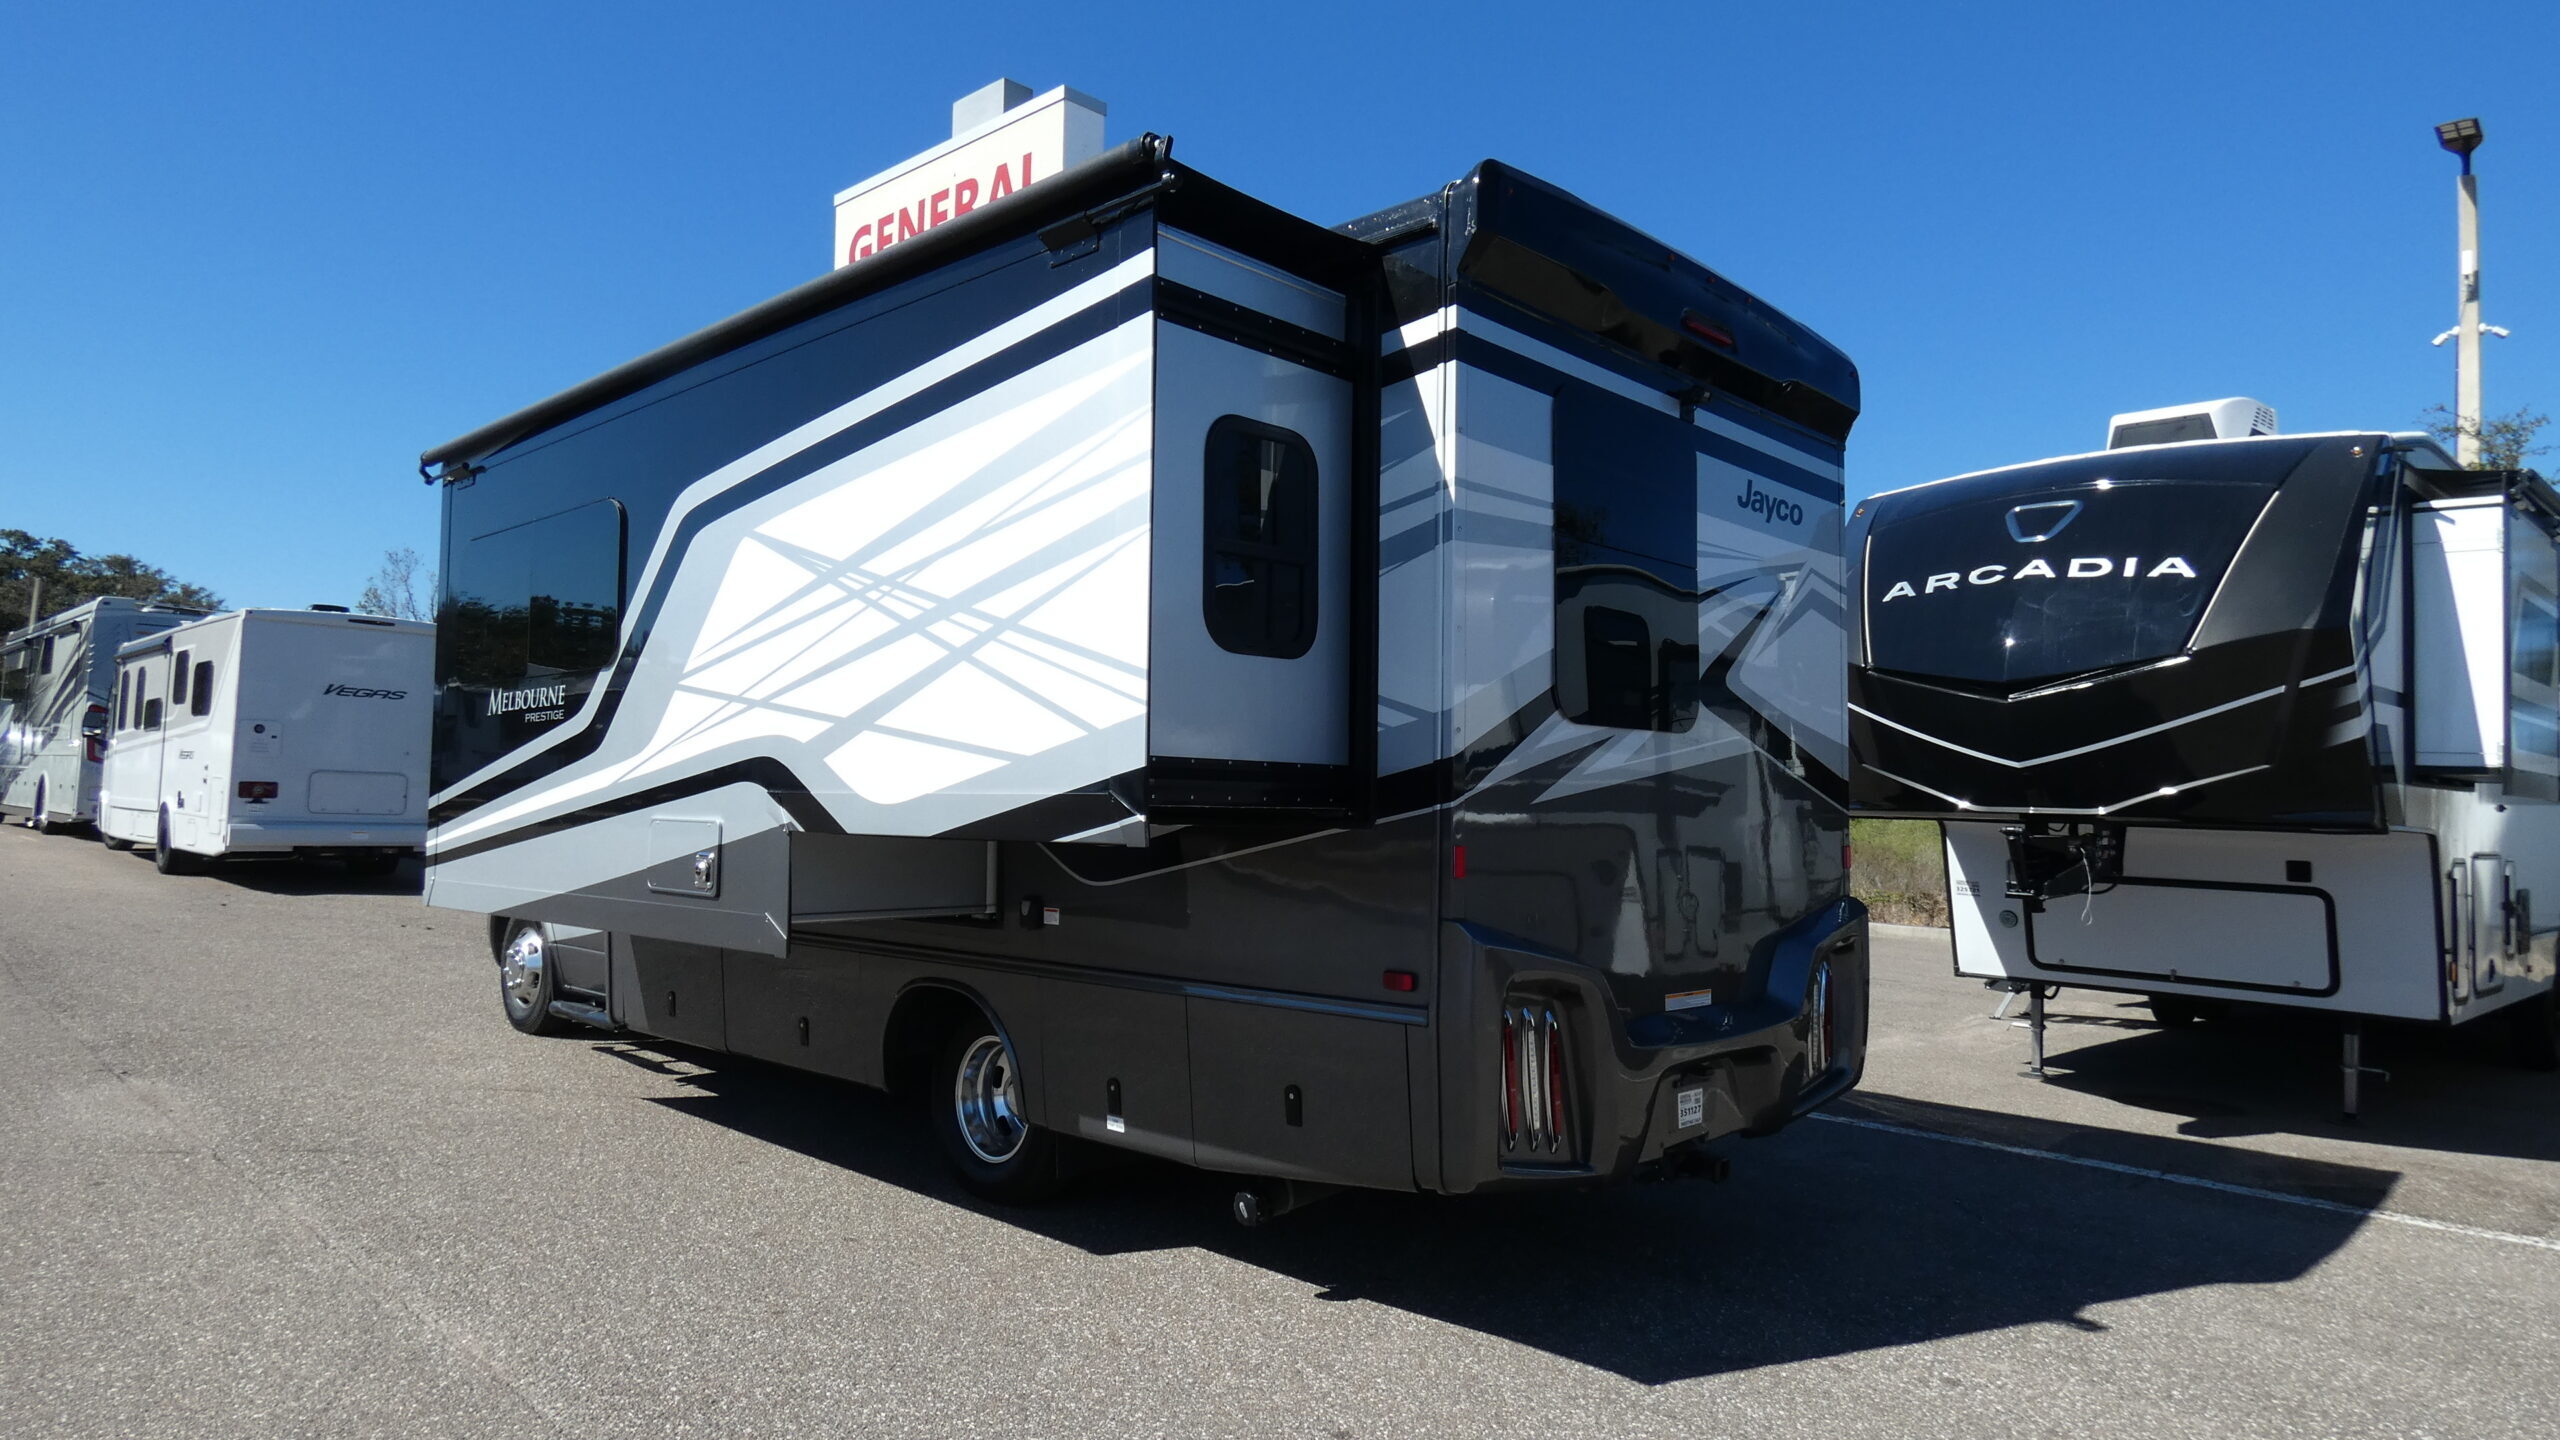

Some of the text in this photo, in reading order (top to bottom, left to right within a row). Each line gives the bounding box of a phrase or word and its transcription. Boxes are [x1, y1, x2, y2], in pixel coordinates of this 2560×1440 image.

[1737, 479, 1803, 526] Jayco
[1882, 556, 2197, 603] ARCADIA
[323, 684, 408, 700] VEGAS
[487, 684, 566, 716] MELBOURNE
[524, 709, 565, 723] PRESTIGE
